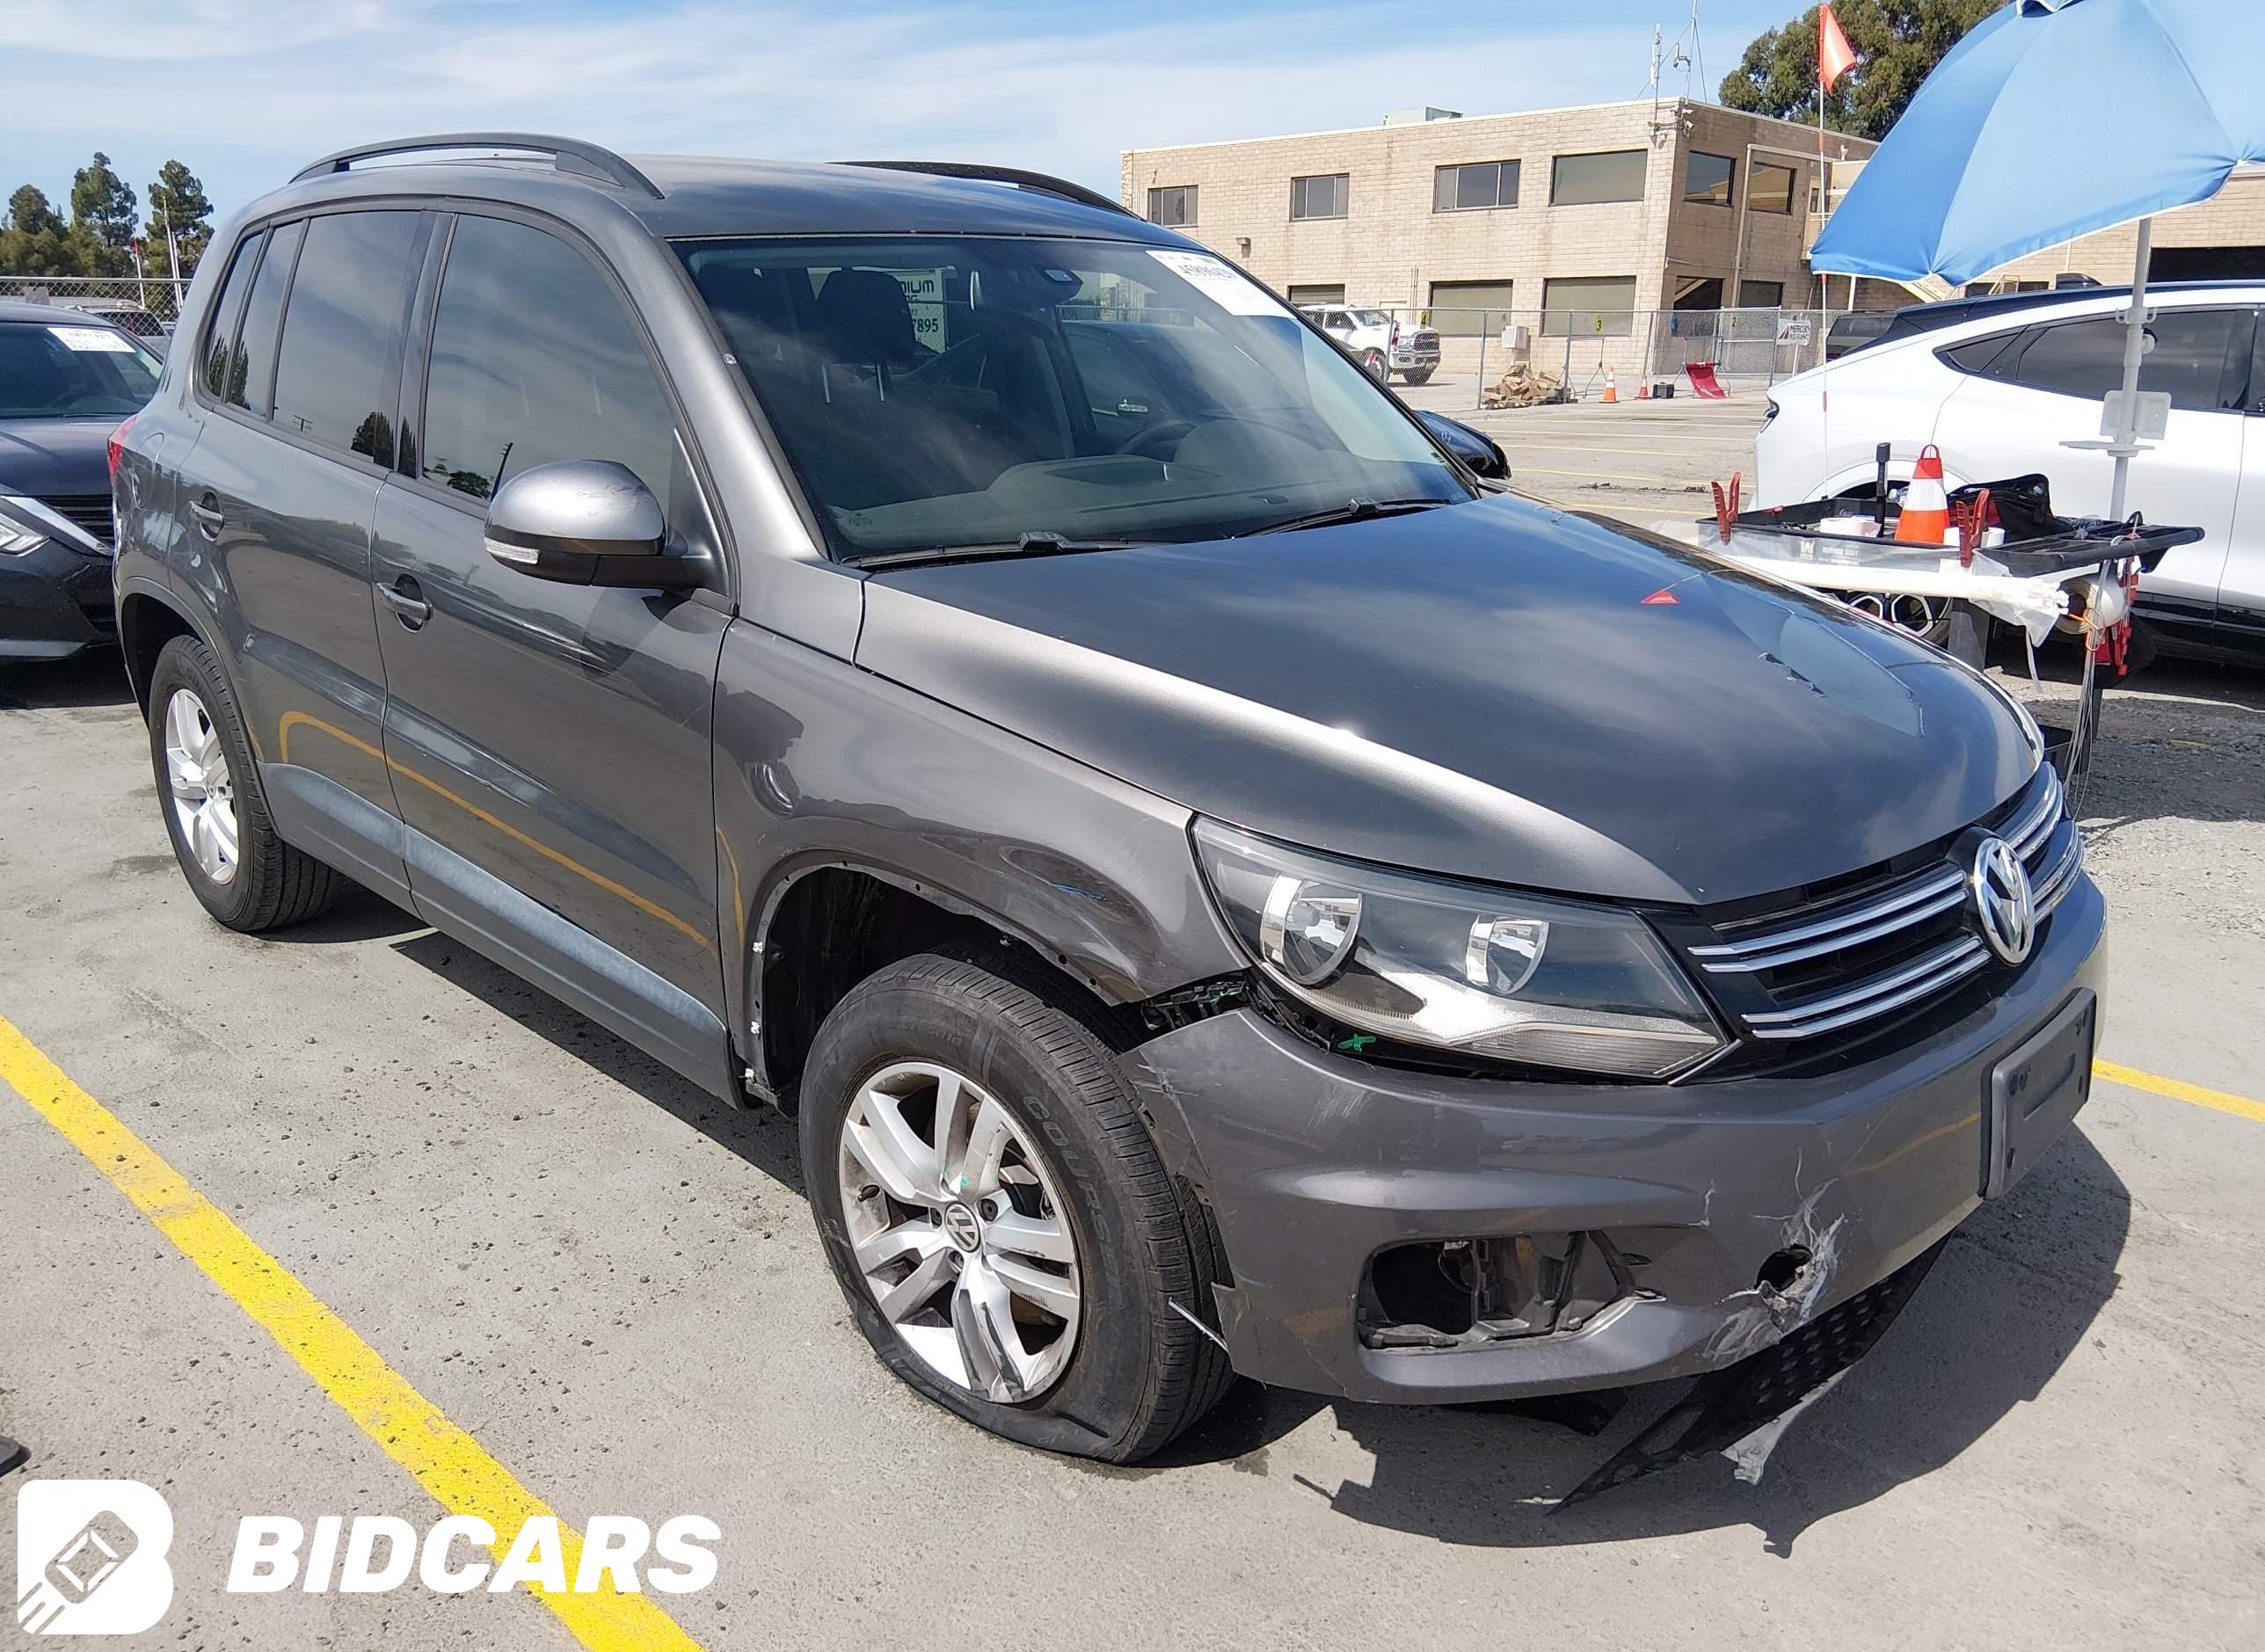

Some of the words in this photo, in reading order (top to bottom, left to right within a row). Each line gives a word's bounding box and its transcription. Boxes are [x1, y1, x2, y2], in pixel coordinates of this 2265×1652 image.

[1596, 319, 1602, 331] 3
[1732, 317, 1737, 327] 2
[1822, 546, 1845, 556] SERVICE
